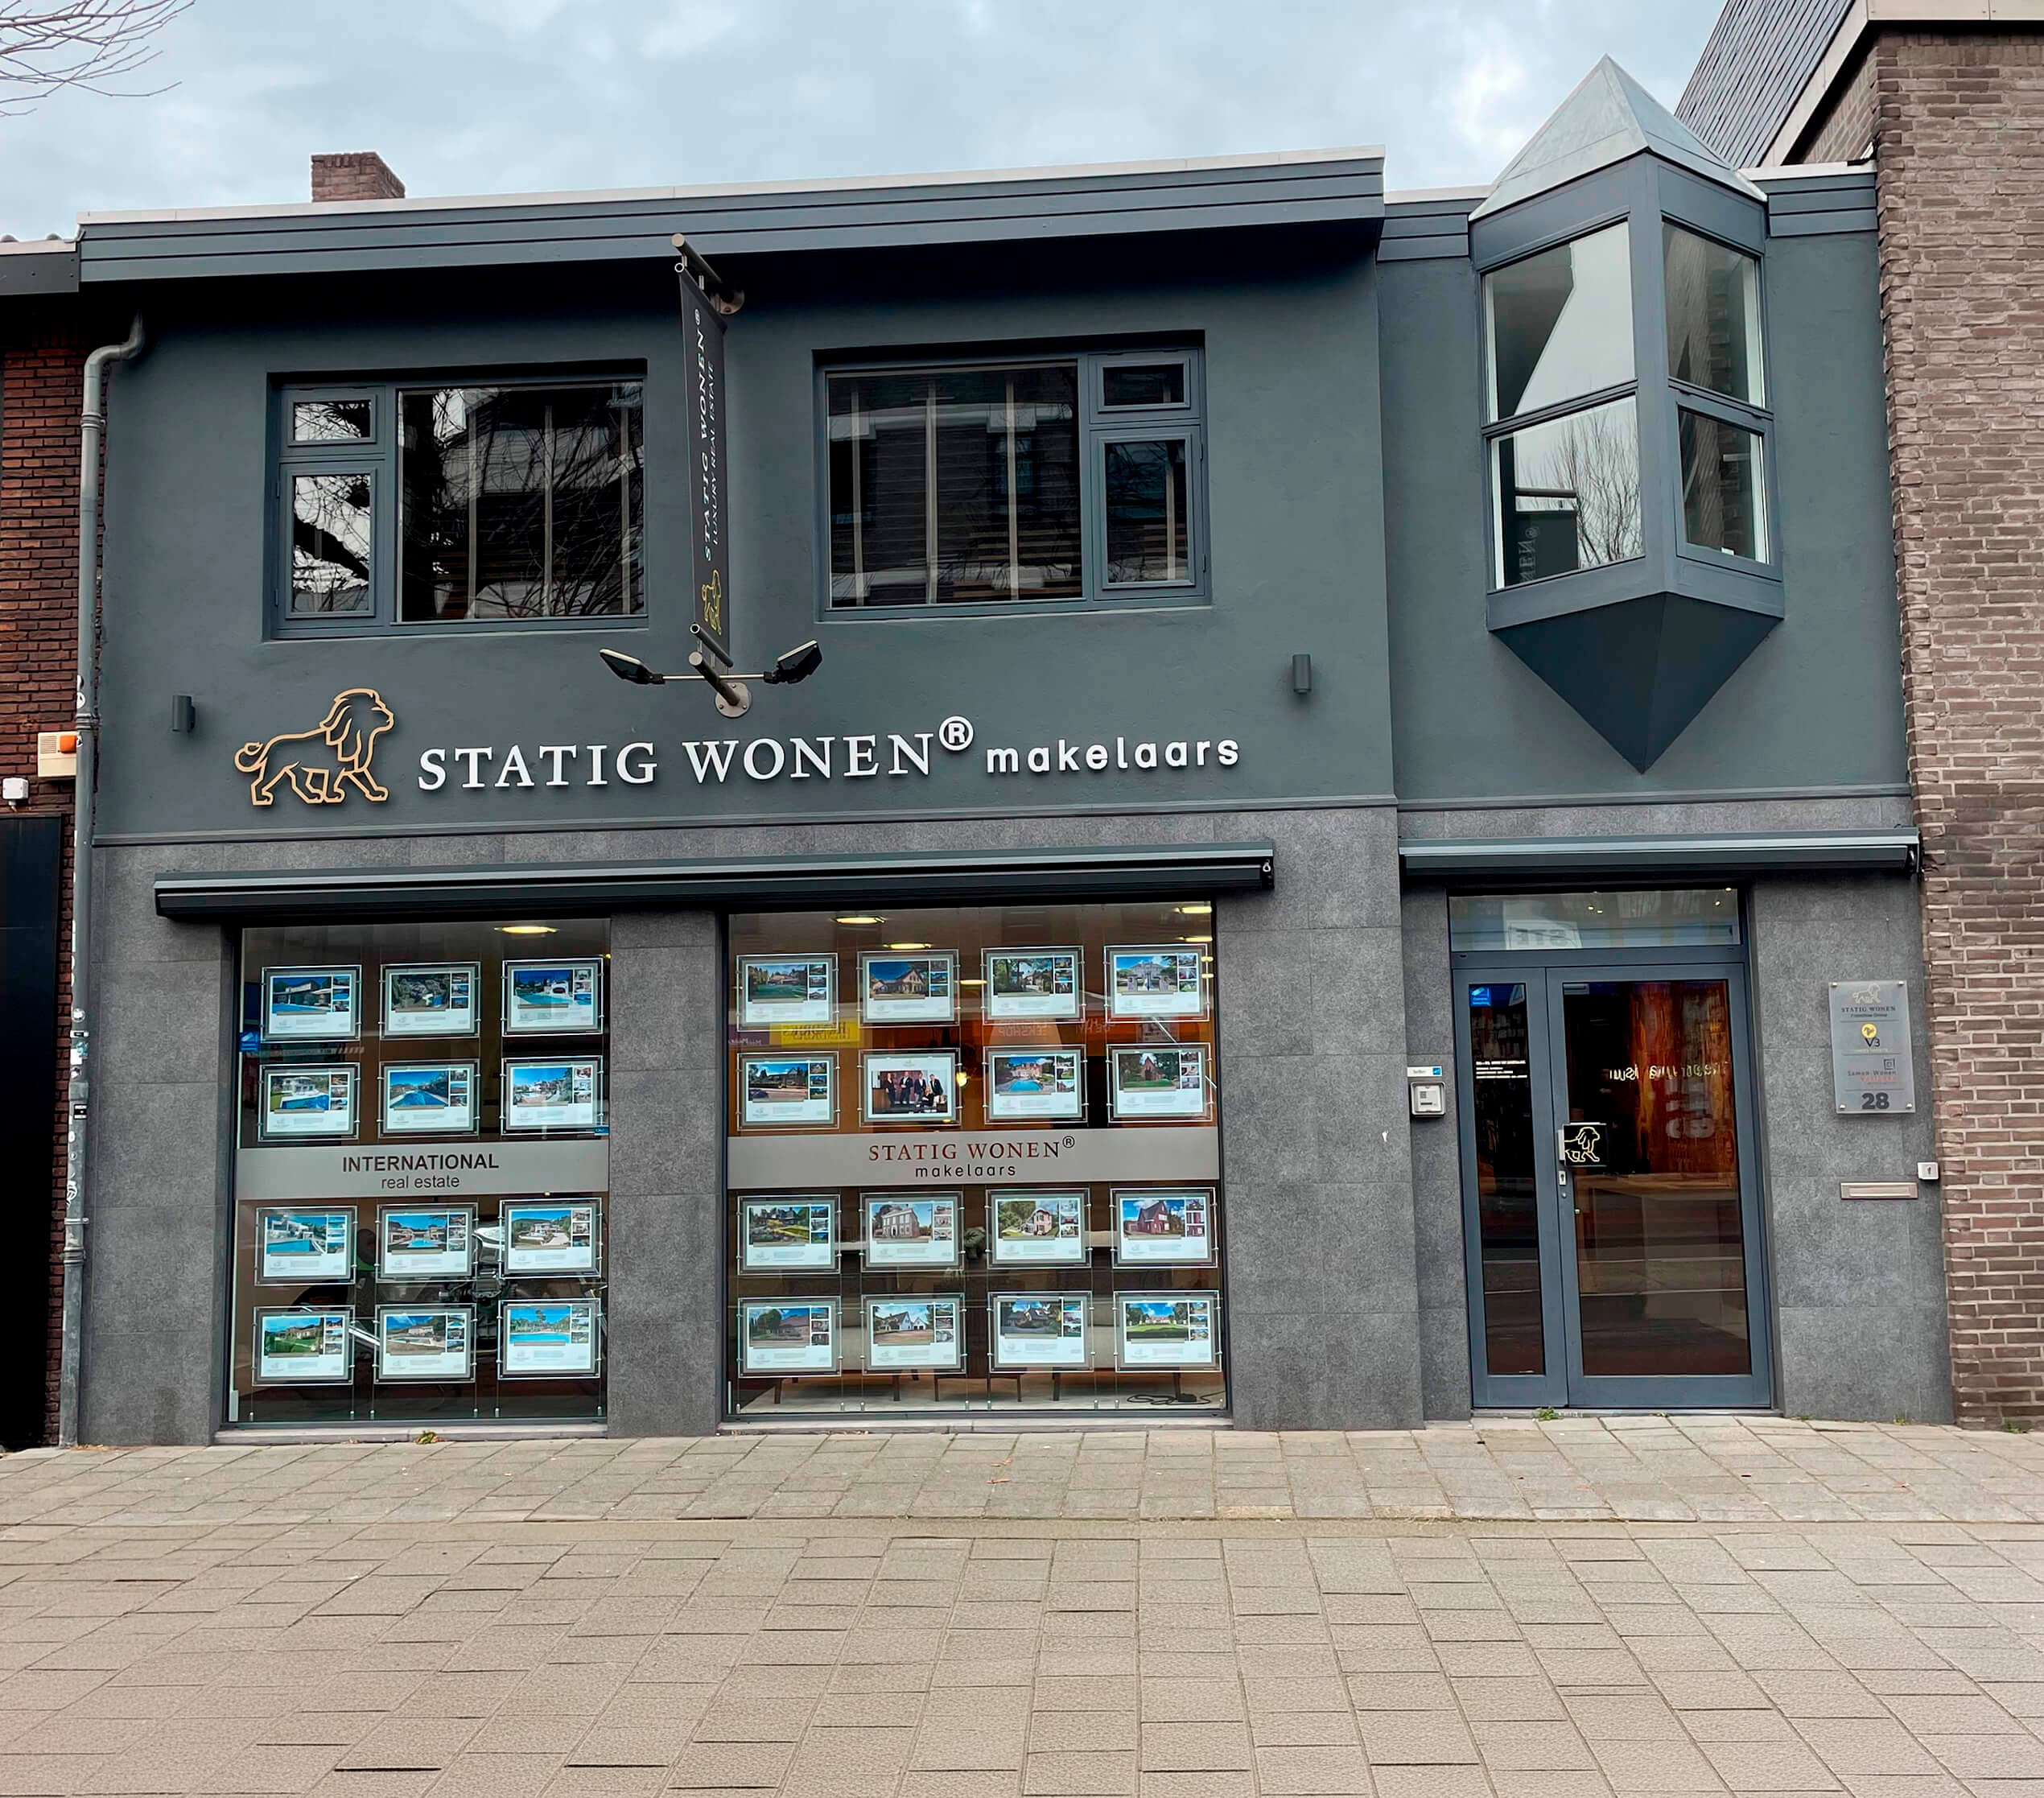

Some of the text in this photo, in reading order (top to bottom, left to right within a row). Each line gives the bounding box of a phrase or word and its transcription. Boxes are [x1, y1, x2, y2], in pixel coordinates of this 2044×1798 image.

[701, 452, 711, 562] STATIG
[711, 471, 719, 545] LUXURY
[418, 742, 657, 791] STATIG
[987, 736, 1239, 773] makelaars
[1865, 1037, 1881, 1047] V3
[1861, 1092, 1889, 1110] 28
[869, 1144, 957, 1161] STATIG
[342, 1153, 499, 1172] INTERNATIONAL
[915, 1164, 1016, 1177] makelaars
[381, 1175, 459, 1189] real estate
